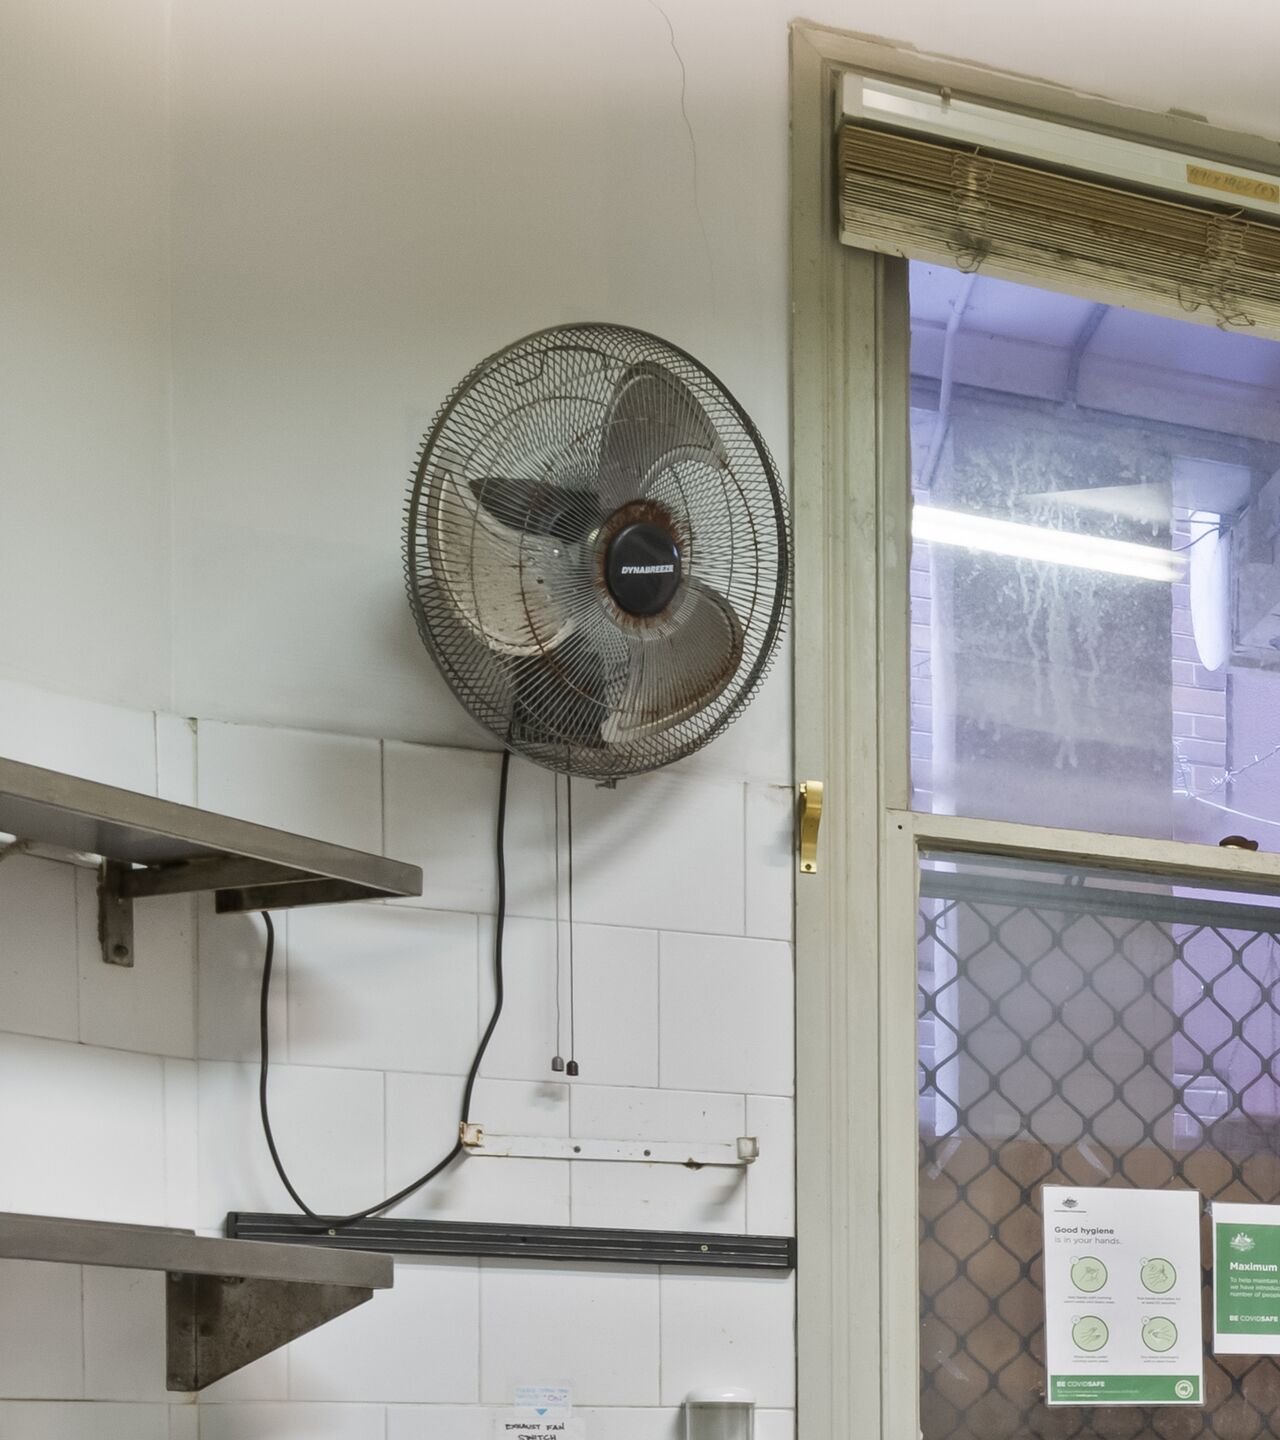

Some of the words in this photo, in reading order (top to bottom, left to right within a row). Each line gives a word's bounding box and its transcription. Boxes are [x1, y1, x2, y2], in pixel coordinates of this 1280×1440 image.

[622, 565, 673, 574] DYNABREEZE
[1081, 1227, 1114, 1235] hygiene
[1230, 1262, 1277, 1272] Maximum
[546, 1422, 565, 1430] FAN
